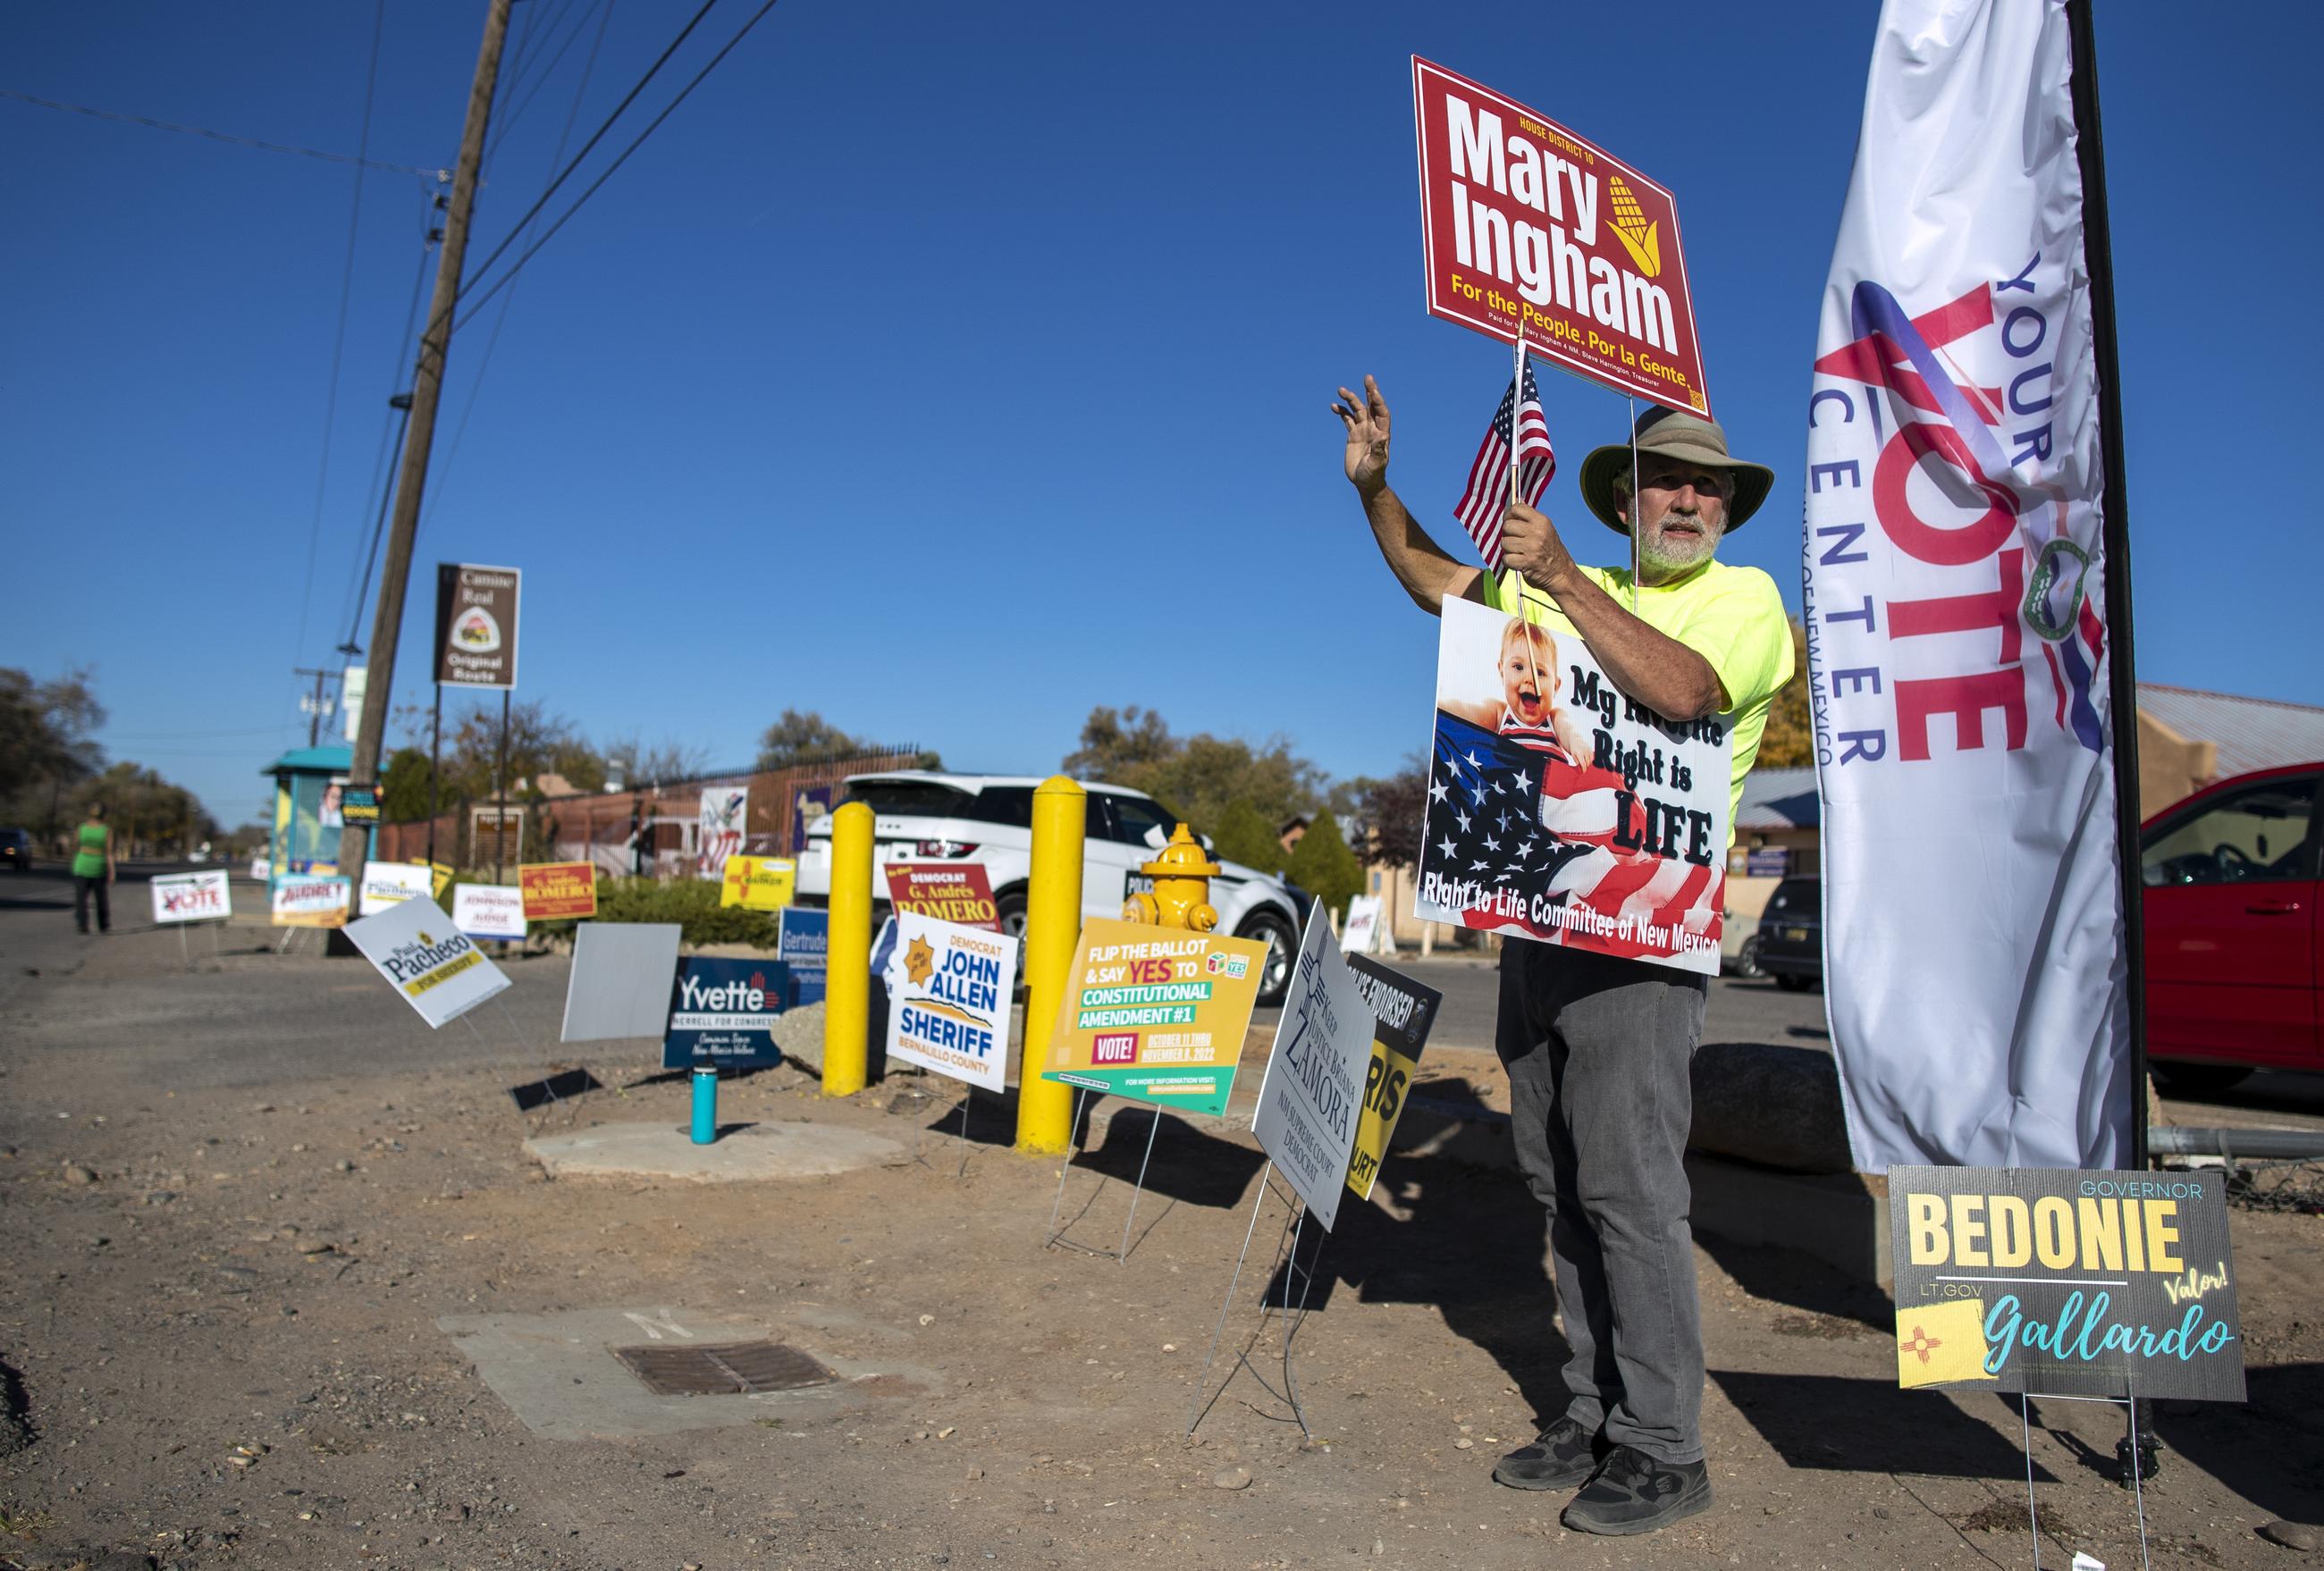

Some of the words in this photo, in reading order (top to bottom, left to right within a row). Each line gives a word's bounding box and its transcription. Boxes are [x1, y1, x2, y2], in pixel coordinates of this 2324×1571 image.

[1520, 116, 1546, 139] HOUSE
[1548, 130, 1582, 158] DISTRICT
[1584, 151, 1594, 164] 10
[1445, 93, 1597, 247] Mary
[1452, 180, 1679, 356] Ingham
[1452, 273, 1482, 301] For
[1487, 290, 1517, 315] the
[1523, 302, 1586, 347] People.
[1588, 330, 1616, 357] Por
[1620, 344, 1636, 367] la
[1639, 352, 1692, 390] Gente.
[1488, 312, 1503, 323] Paid
[1503, 318, 1513, 328] for
[1524, 326, 1539, 339] Mary
[1540, 332, 1562, 349] Ingham
[1562, 341, 1569, 350] 4
[1581, 350, 1599, 363] Steve
[1631, 371, 1660, 387] Treasurer
[1996, 250, 2053, 469] YOUR
[1815, 280, 2028, 762] VOTE
[460, 571, 515, 588] Camino
[462, 588, 493, 605] Real
[1809, 387, 1887, 767] CENTER
[1805, 605, 1822, 663] NEW
[447, 652, 502, 670] Original
[1570, 665, 1617, 729] My
[1811, 671, 1832, 767] MEXICO
[1593, 728, 1664, 792] Right
[1670, 755, 1692, 792] is
[1612, 791, 1713, 866] LIFE
[908, 884, 925, 899] G.
[928, 883, 975, 899] Andrés
[910, 872, 967, 883] DEMOCRAT
[1423, 871, 1470, 912] Right
[1475, 883, 1491, 913] to
[1496, 886, 1526, 920] Life
[1531, 894, 1614, 937] Committee
[1618, 912, 1634, 941] of
[1637, 916, 1669, 948] New
[1671, 923, 1718, 959] Mexico
[382, 934, 470, 983] Pacheco
[392, 941, 419, 960] Paul
[941, 948, 1000, 986] JOHN
[950, 935, 1003, 957] DEMOCRAT
[1089, 945, 1119, 962] FLIP
[1121, 944, 1149, 960] THE
[1150, 938, 1208, 958] BALLOT
[1085, 969, 1097, 984] &
[1099, 966, 1126, 983] SAY
[1130, 958, 1172, 984] YES
[1175, 962, 1198, 978] TO
[1230, 962, 1244, 973] YES
[678, 974, 764, 1012] Yvette
[930, 972, 998, 1012] ALLEN
[1083, 983, 1209, 1005] CONSTITUTIONAL
[1366, 979, 1415, 1031] ENDORSED
[714, 1016, 731, 1027] FOR
[900, 1007, 993, 1057] SHERIFF
[1079, 1007, 1173, 1028] AMENDMENT
[1173, 1006, 1191, 1022] #1
[1322, 996, 1338, 1038] KEEP
[898, 1036, 949, 1062] BERNALILLO
[950, 1054, 989, 1075] COUNTY
[1098, 1037, 1133, 1061] VOTE!
[1142, 1048, 1183, 1062] NOVEMBER
[1193, 1047, 1216, 1061] 2022
[1148, 1034, 1182, 1047] OCTOBER
[1183, 1033, 1190, 1046] 11
[1191, 1032, 1212, 1046] THRU
[1307, 1008, 1332, 1066] JUSTICE
[1330, 1049, 1356, 1104] BRIANA
[1156, 1077, 1198, 1085] INFORMATION
[1285, 1000, 1350, 1145] ZAMORA
[1277, 1089, 1291, 1117] NM
[1288, 1106, 1315, 1153] SUPREME
[1312, 1142, 1335, 1179] COURT
[1284, 1129, 1318, 1183] DEMOCRAT
[2080, 1180, 2204, 1200] GOVERNOR
[1907, 1194, 2184, 1273] BEDONIE
[1920, 1283, 1983, 1298] LT.GOV
[2163, 1261, 2228, 1304] Valor!
[1983, 1290, 2235, 1374] Gallardo
